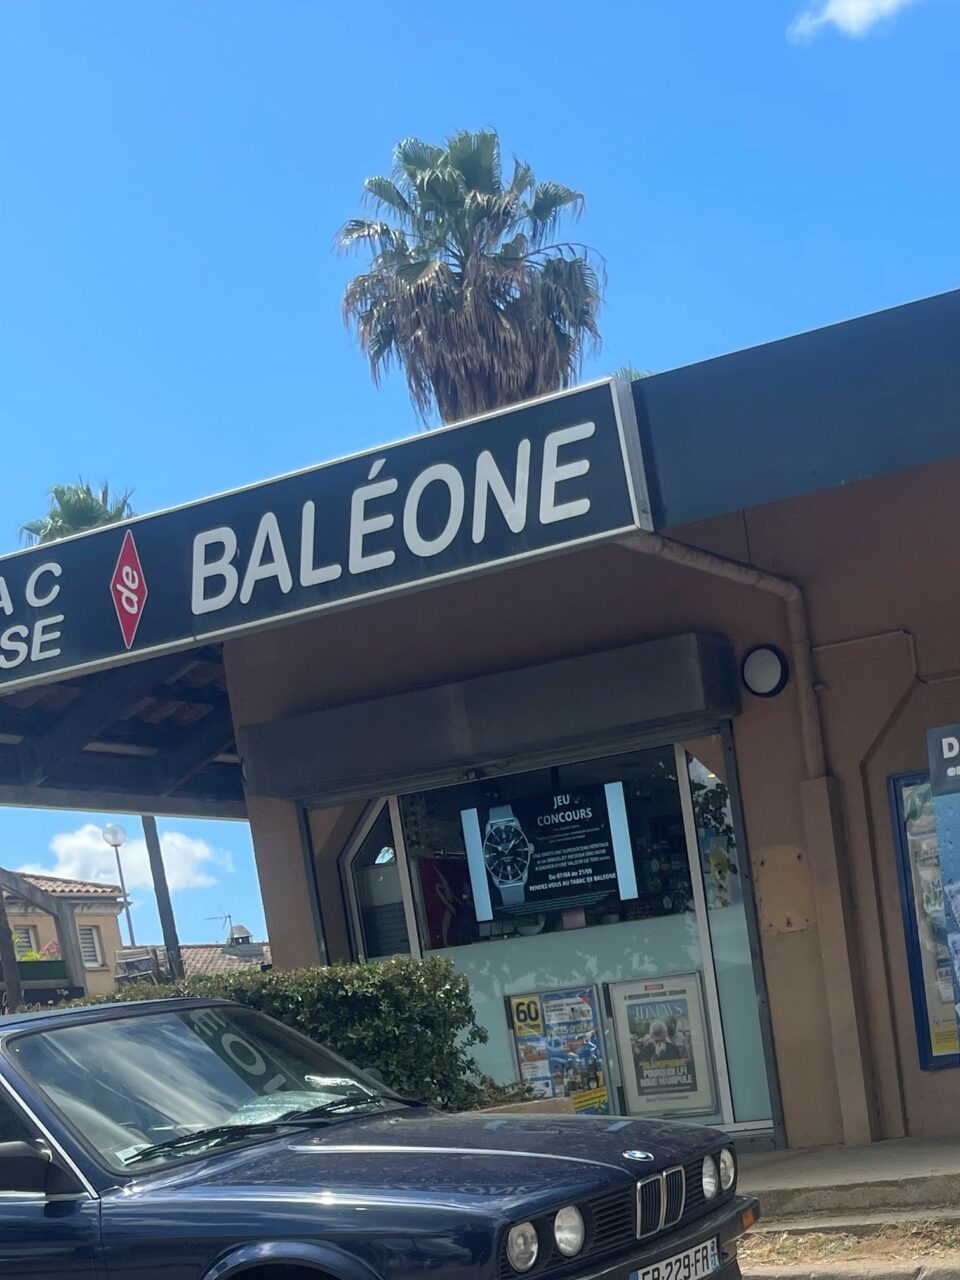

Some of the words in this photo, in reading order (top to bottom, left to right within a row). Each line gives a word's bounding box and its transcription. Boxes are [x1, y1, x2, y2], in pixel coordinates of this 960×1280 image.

[191, 420, 596, 616] BALÉONE
[116, 565, 139, 614] de
[0, 614, 65, 669] SE
[537, 808, 592, 826] CONCOURS
[553, 794, 570, 809] JEU
[516, 1000, 539, 1023] 60
